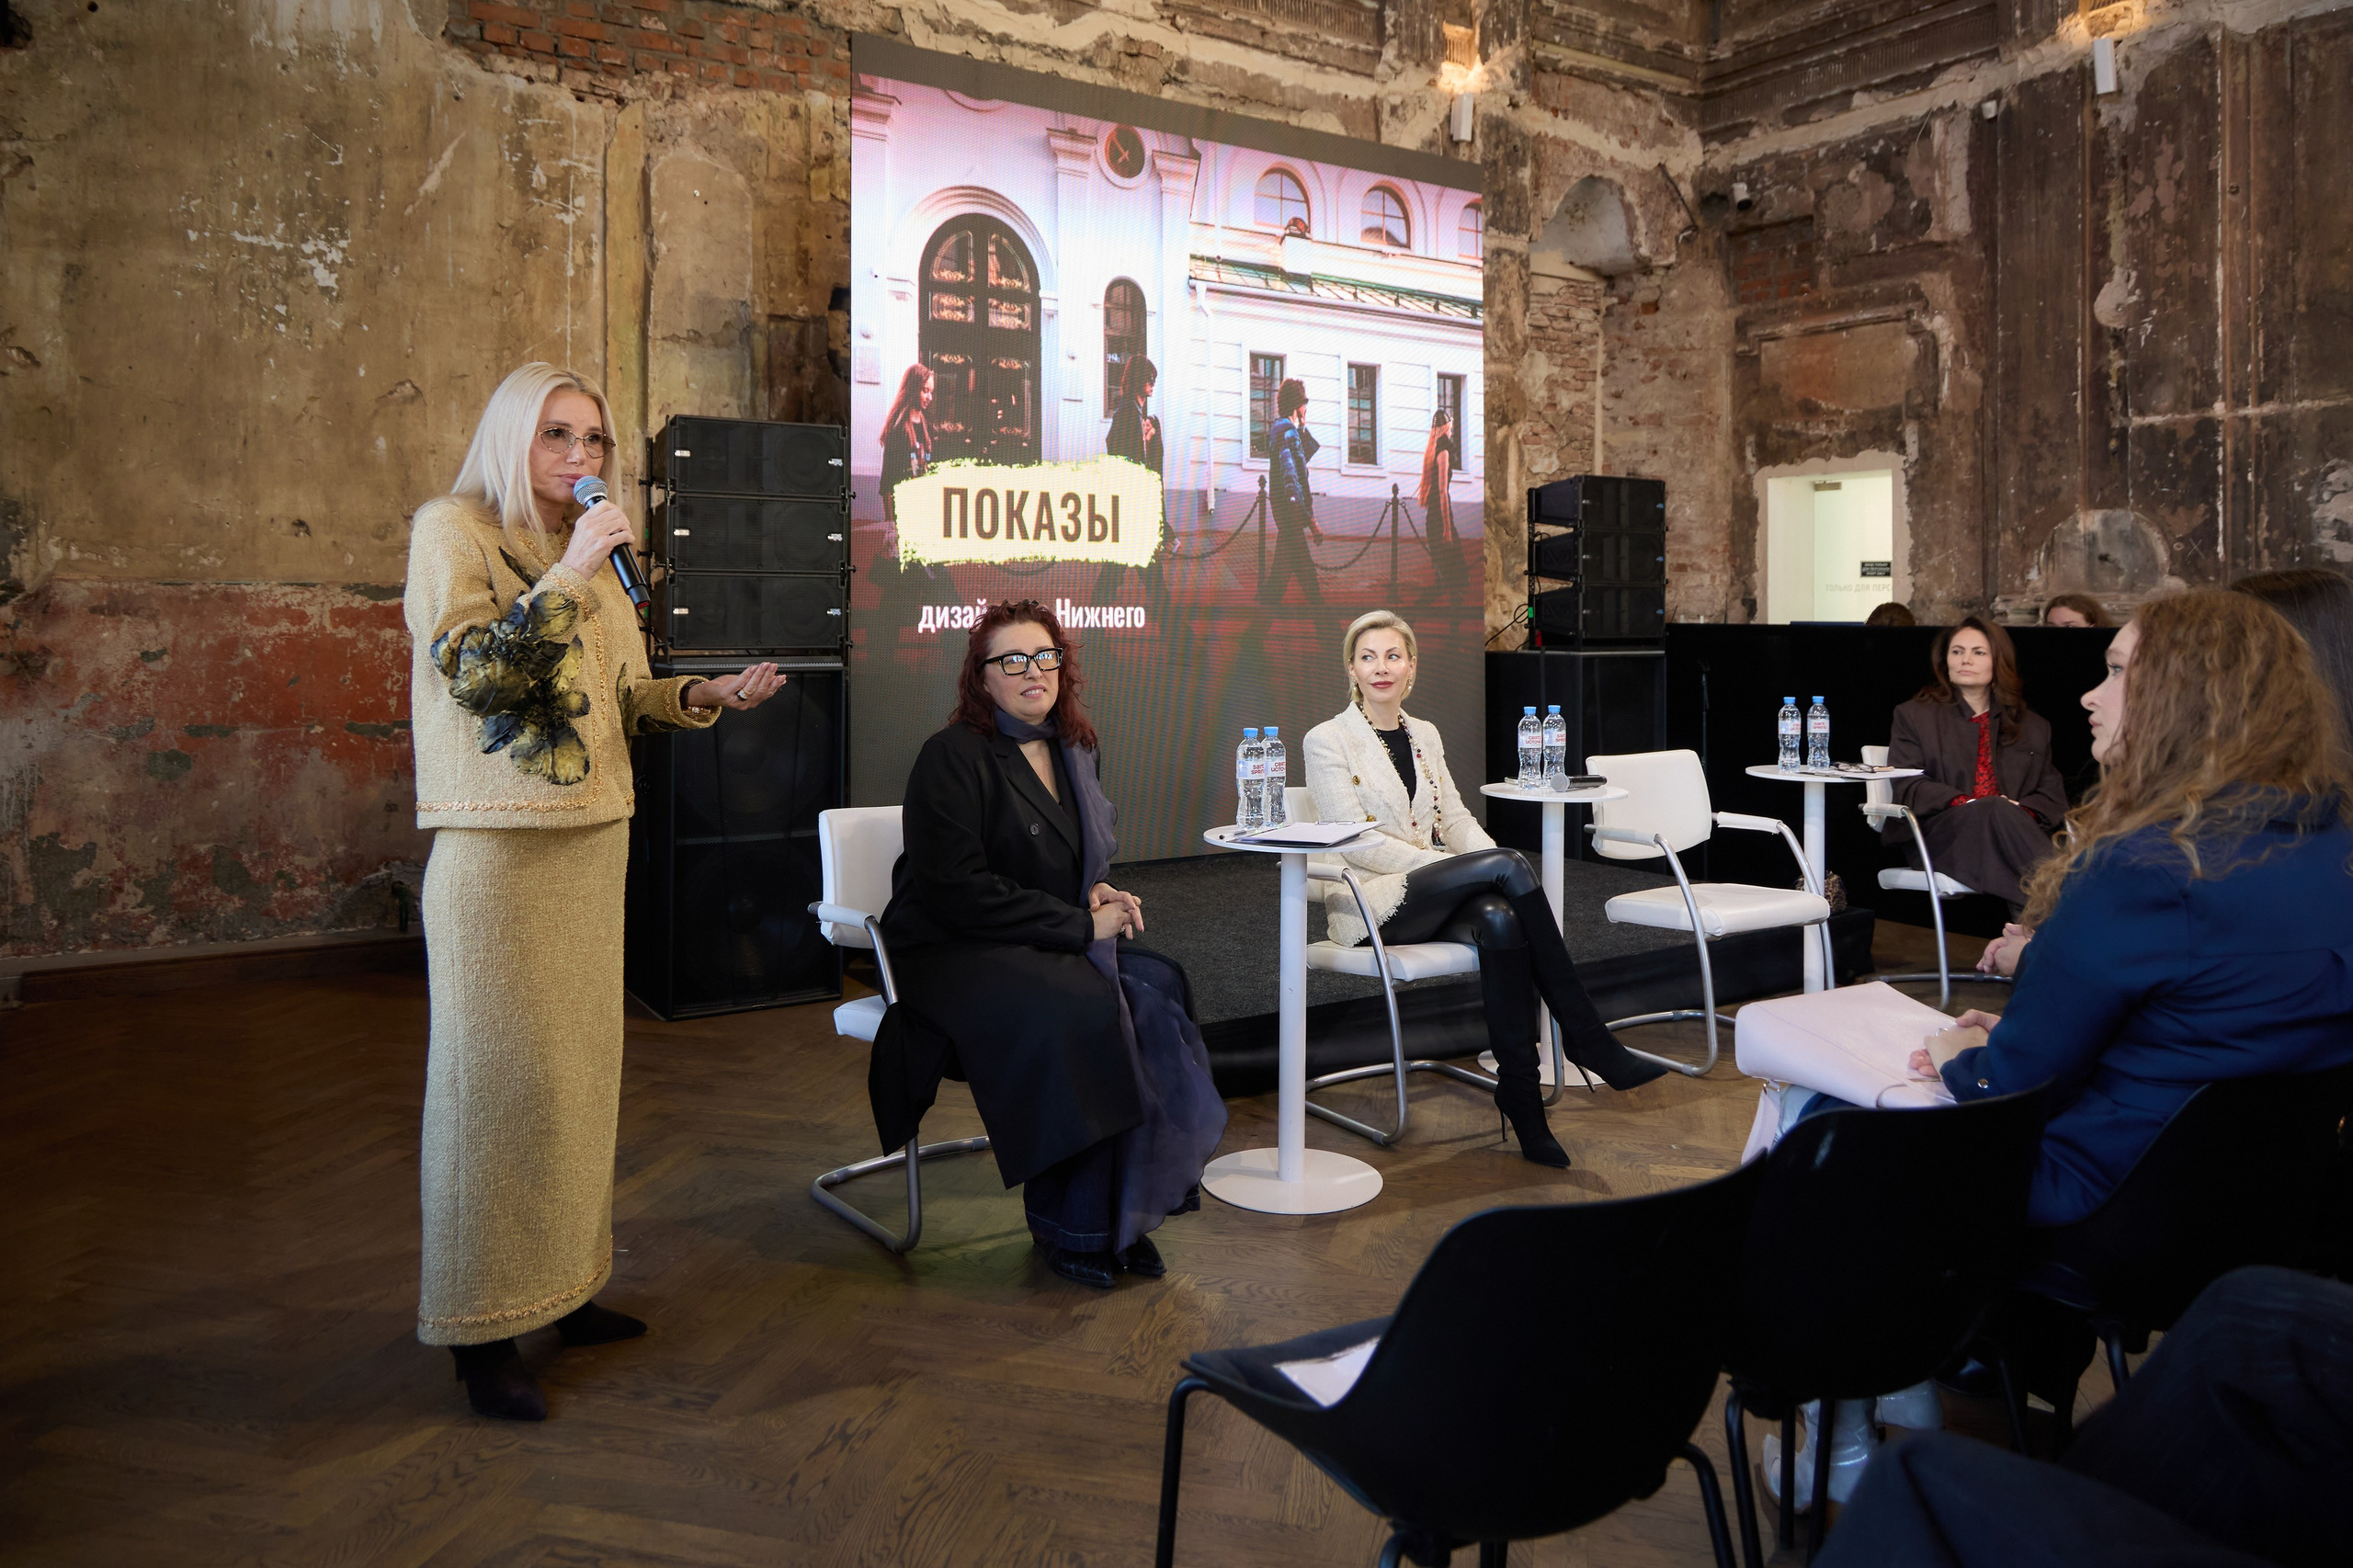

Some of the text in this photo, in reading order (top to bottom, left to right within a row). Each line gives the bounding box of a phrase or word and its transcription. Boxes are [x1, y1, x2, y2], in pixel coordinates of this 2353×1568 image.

[942, 486, 1120, 543] ПОКАЗЫ
[1855, 584, 1870, 593] ДЛЯ
[917, 597, 1145, 634] дизай Нижнего
